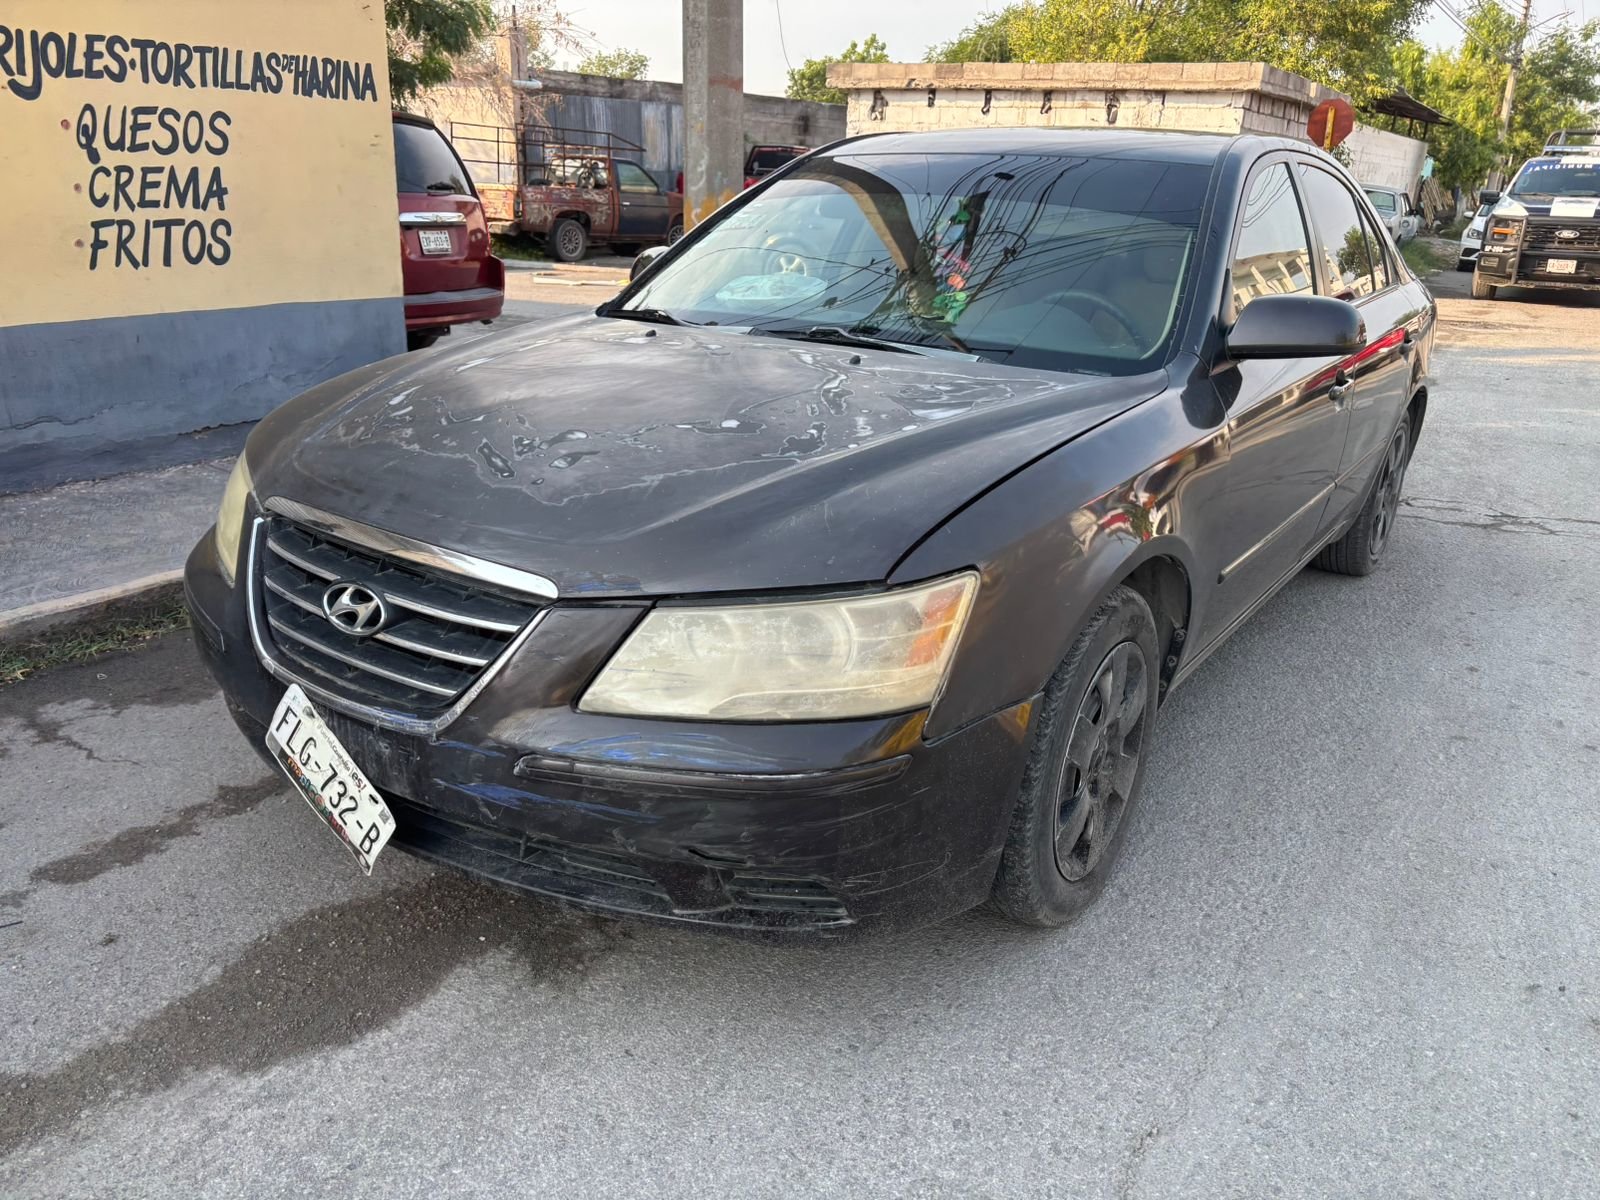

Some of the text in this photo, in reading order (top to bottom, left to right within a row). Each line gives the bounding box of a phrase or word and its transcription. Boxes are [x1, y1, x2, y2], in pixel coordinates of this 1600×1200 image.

[131, 39, 282, 94] TORTILLAS
[282, 54, 296, 74] DE
[293, 55, 378, 102] HARINA
[76, 103, 232, 164] QUESOS
[89, 165, 229, 212] CREMA
[89, 218, 232, 270] FRITOS
[276, 705, 380, 855] FLG-732-B
